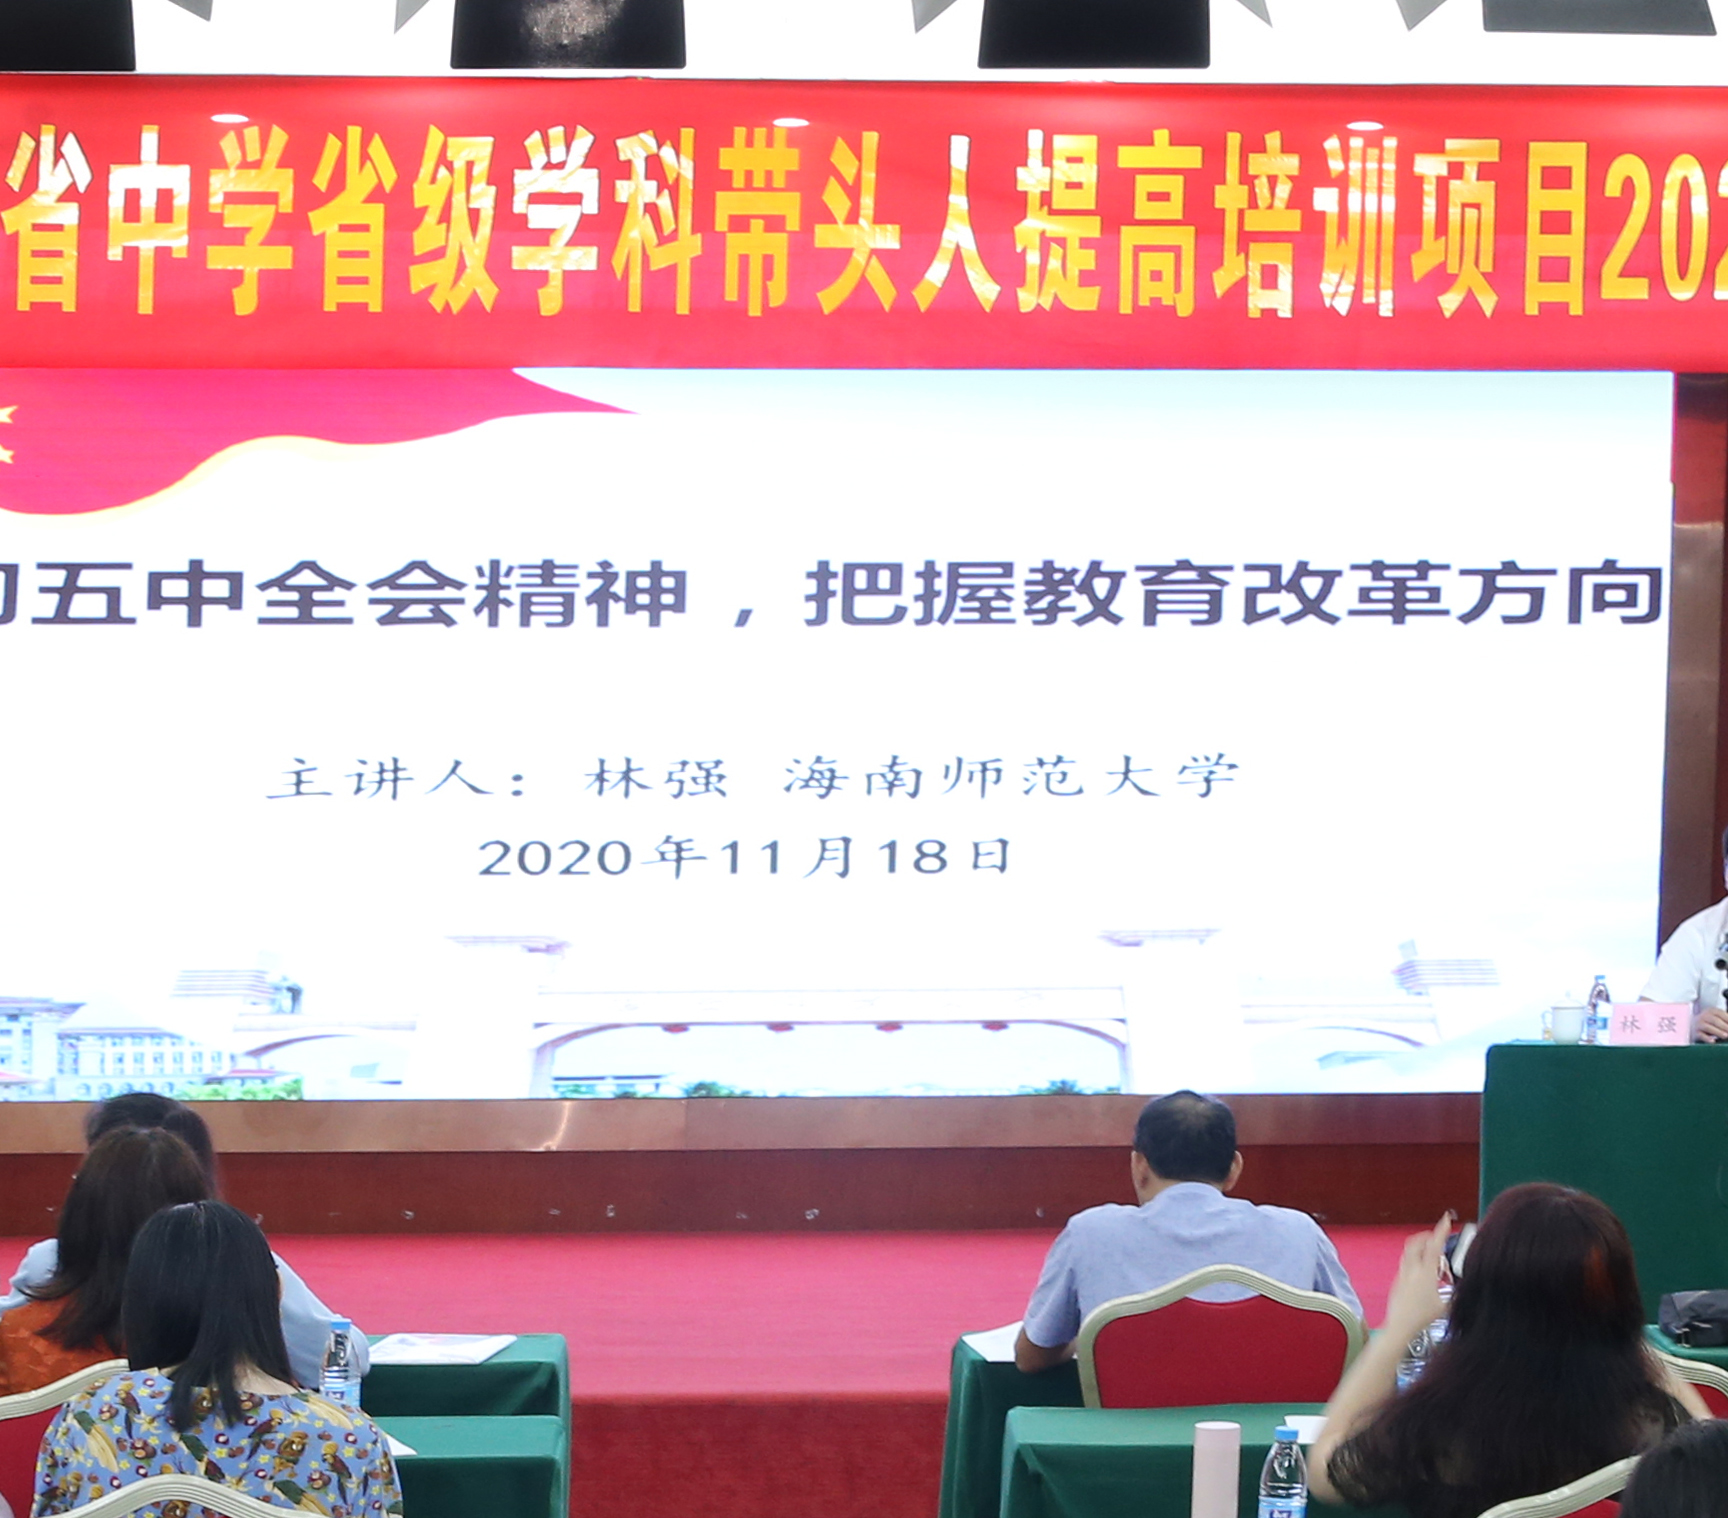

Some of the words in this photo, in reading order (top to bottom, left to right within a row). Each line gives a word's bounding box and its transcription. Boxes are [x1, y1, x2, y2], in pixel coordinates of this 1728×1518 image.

[782, 752, 1241, 801] 海南师范大学
[477, 833, 1011, 882] 2020年11月18日
